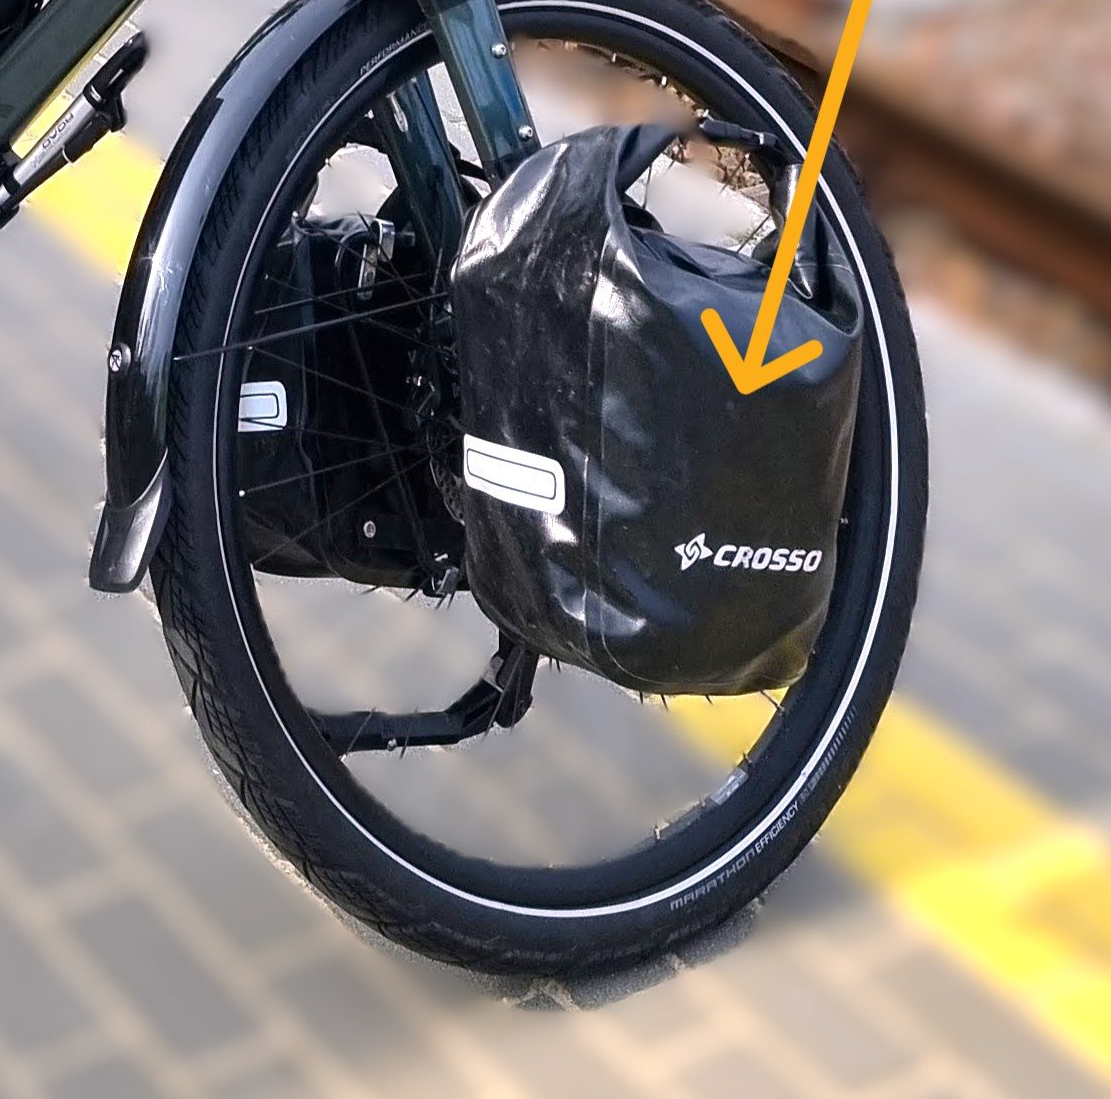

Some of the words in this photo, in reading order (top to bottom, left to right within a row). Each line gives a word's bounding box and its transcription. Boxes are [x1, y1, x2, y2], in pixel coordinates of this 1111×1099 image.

[360, 21, 428, 76] PERFORMAN
[713, 544, 823, 572] CROSSO
[670, 849, 756, 911] MARATHON
[755, 800, 800, 854] EFFICIENCY
